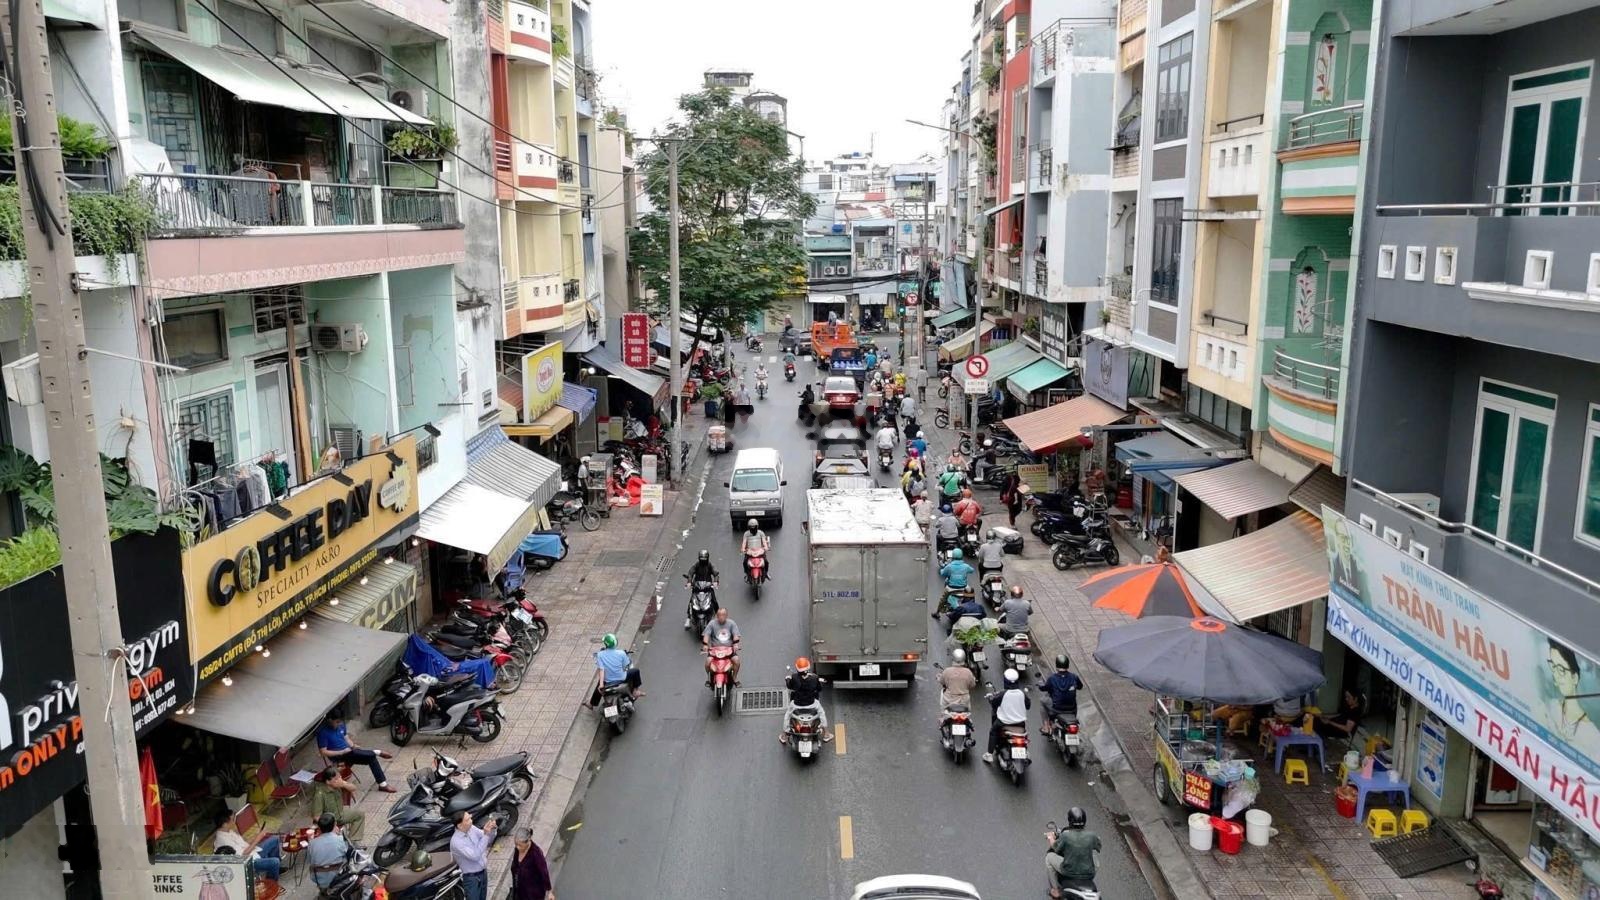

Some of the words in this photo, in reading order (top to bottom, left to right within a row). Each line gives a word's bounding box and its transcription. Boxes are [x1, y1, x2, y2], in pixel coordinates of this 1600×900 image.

[207, 506, 326, 607] COFFEE
[327, 478, 373, 540] DAY
[256, 561, 311, 609] SPECIALTY
[127, 619, 180, 676] gym
[223, 642, 243, 664] CMT8
[1382, 574, 1446, 640] TRẦN
[1452, 617, 1511, 681] HẬU
[1351, 626, 1380, 660] KÍNH
[1417, 672, 1466, 725] TRANG
[1474, 708, 1541, 782] TRẦN
[14, 723, 68, 776] ONLY
